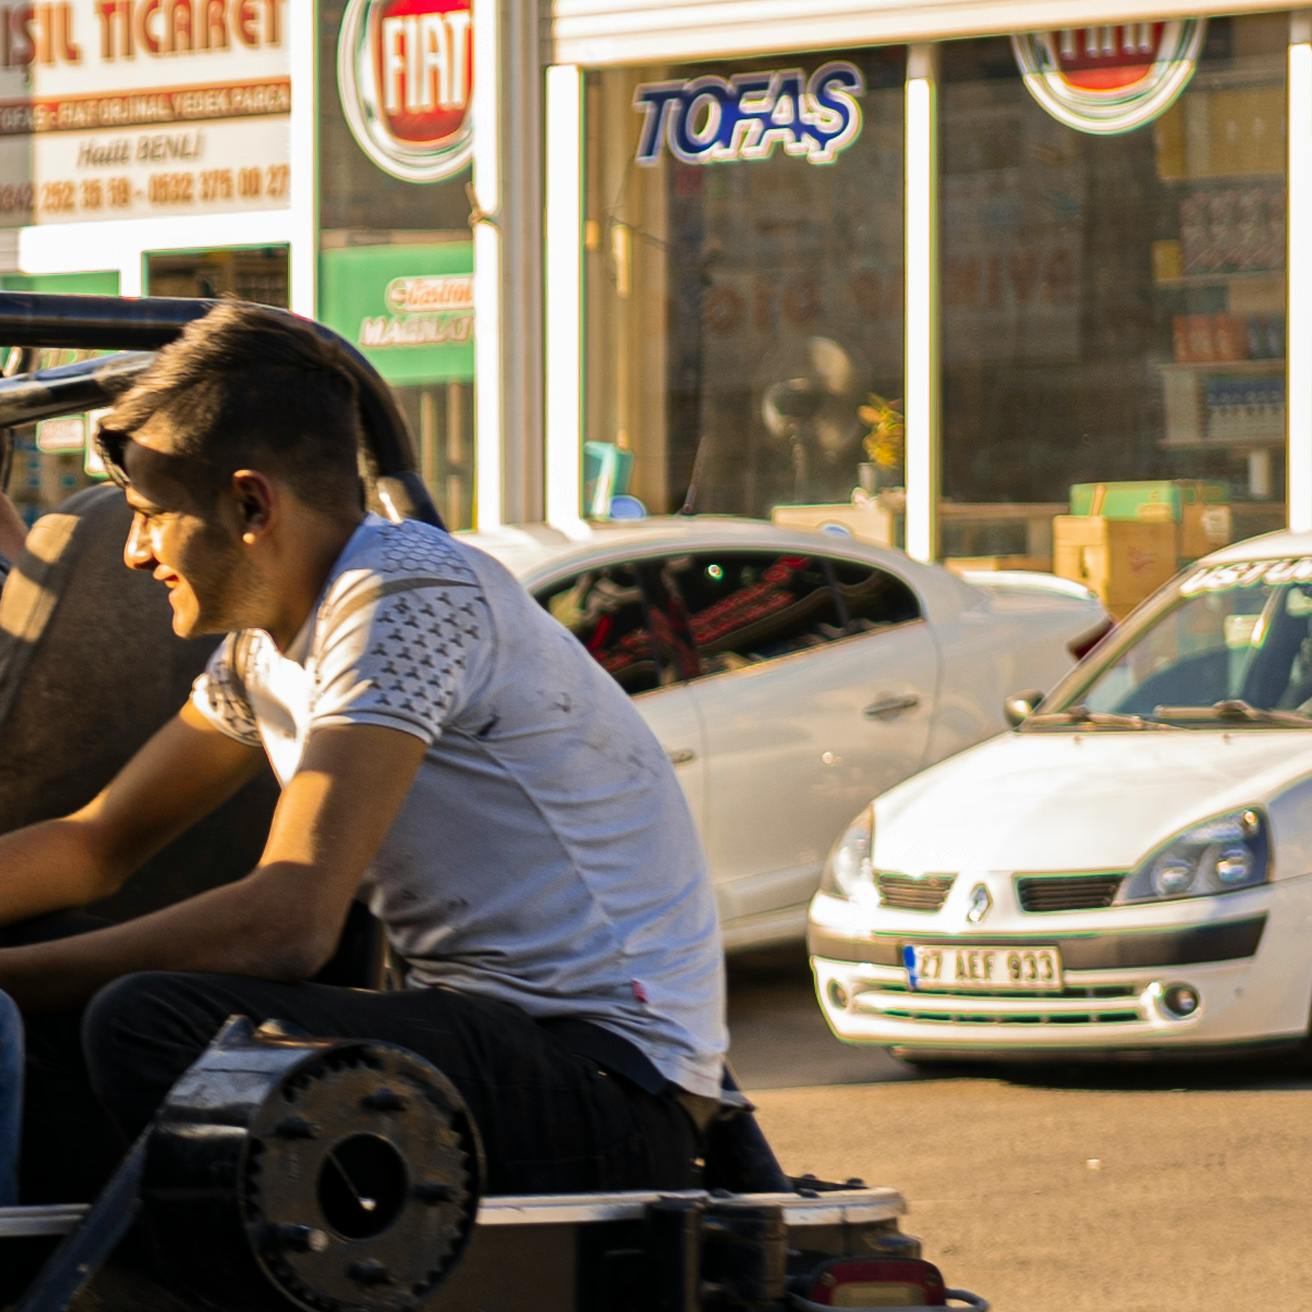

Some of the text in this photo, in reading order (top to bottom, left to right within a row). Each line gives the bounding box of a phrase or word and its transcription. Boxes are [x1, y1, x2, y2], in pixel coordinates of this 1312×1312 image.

[382, 10, 473, 115] FIAT
[921, 949, 1055, 983] 27 AEF 933
